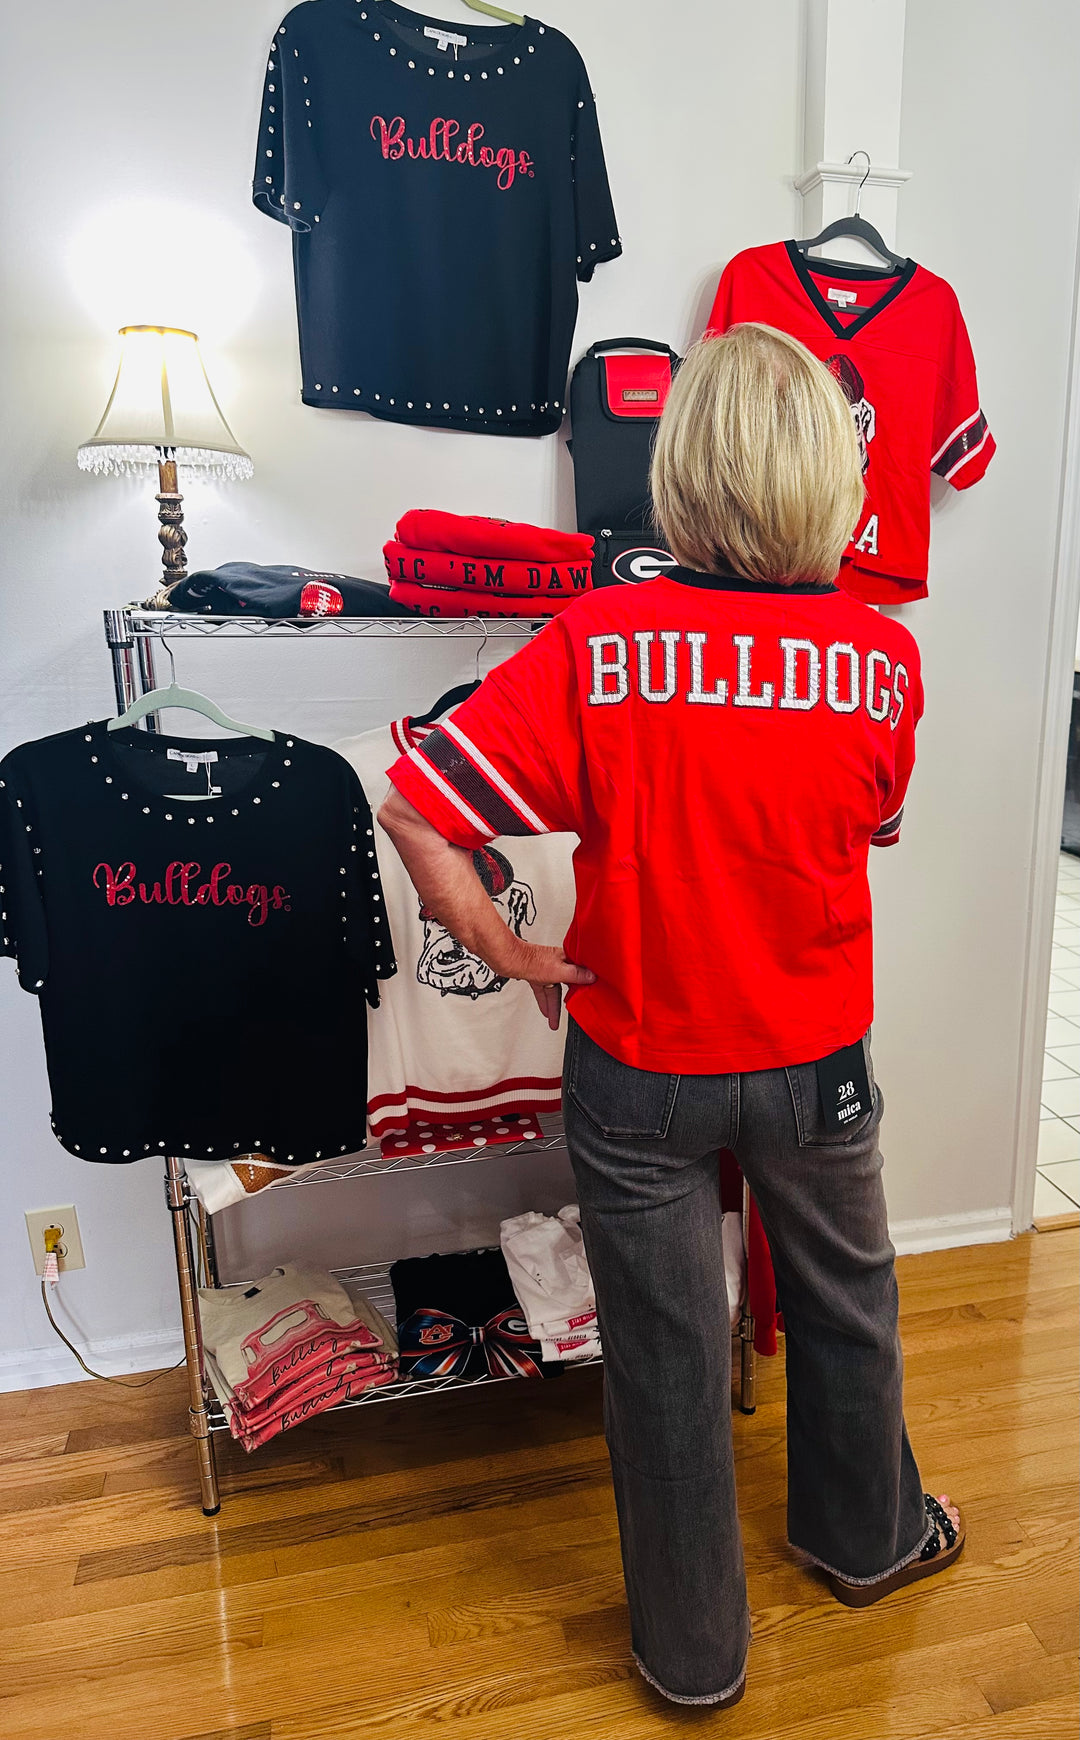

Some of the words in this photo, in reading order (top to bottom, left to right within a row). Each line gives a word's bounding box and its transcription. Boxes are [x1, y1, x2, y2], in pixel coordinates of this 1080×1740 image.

[370, 115, 534, 190] Bulldogs
[849, 513, 879, 555] A
[587, 629, 909, 732] BULLDOGS
[93, 861, 291, 926] Bulldogs
[837, 1101, 861, 1121] mica
[838, 1081, 855, 1101] 28
